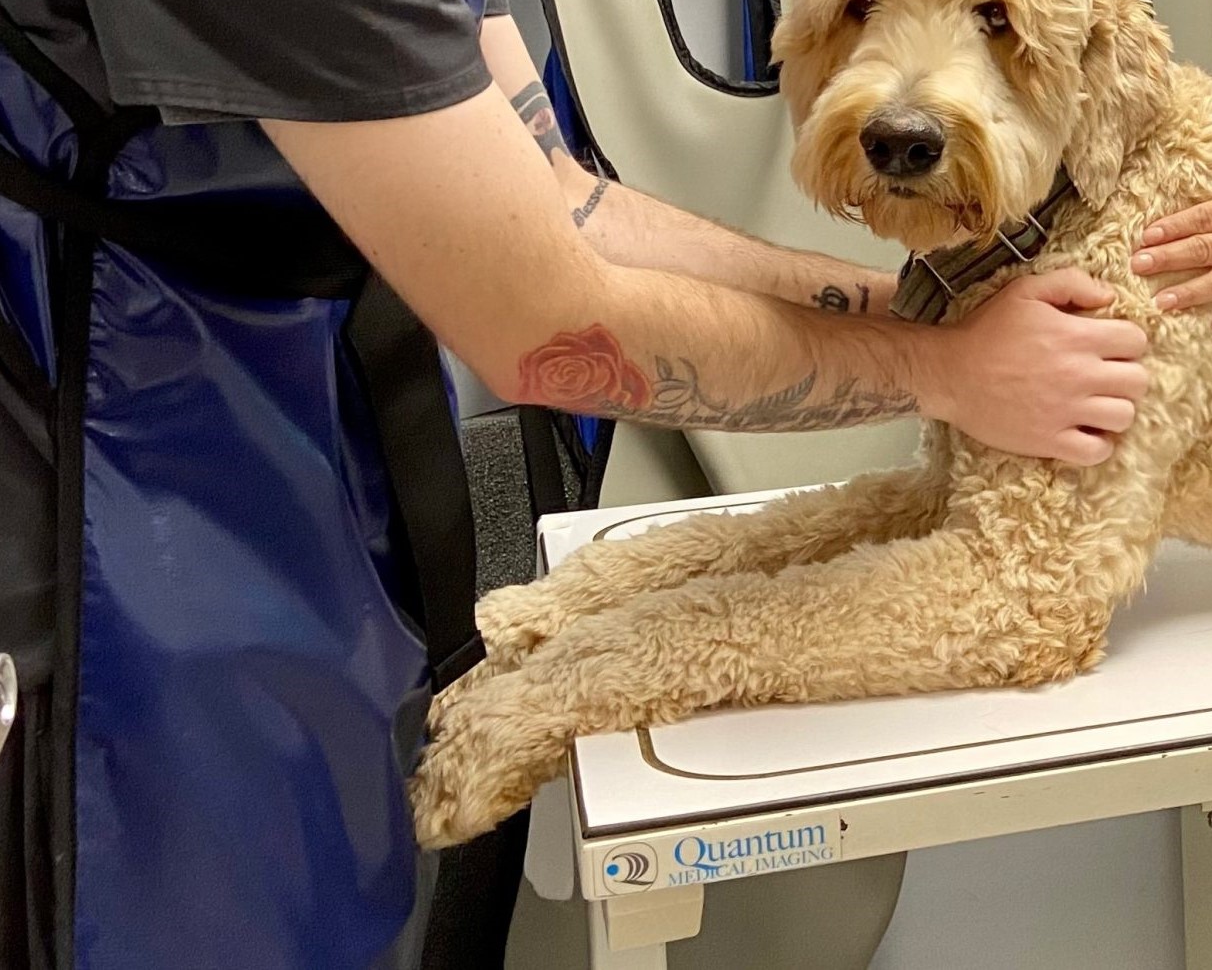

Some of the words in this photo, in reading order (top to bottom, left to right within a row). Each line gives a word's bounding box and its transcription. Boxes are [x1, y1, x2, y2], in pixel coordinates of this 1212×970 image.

[668, 864, 753, 887] MEDICAL
[756, 846, 834, 872] IMAGING
[674, 825, 825, 871] Quantum
